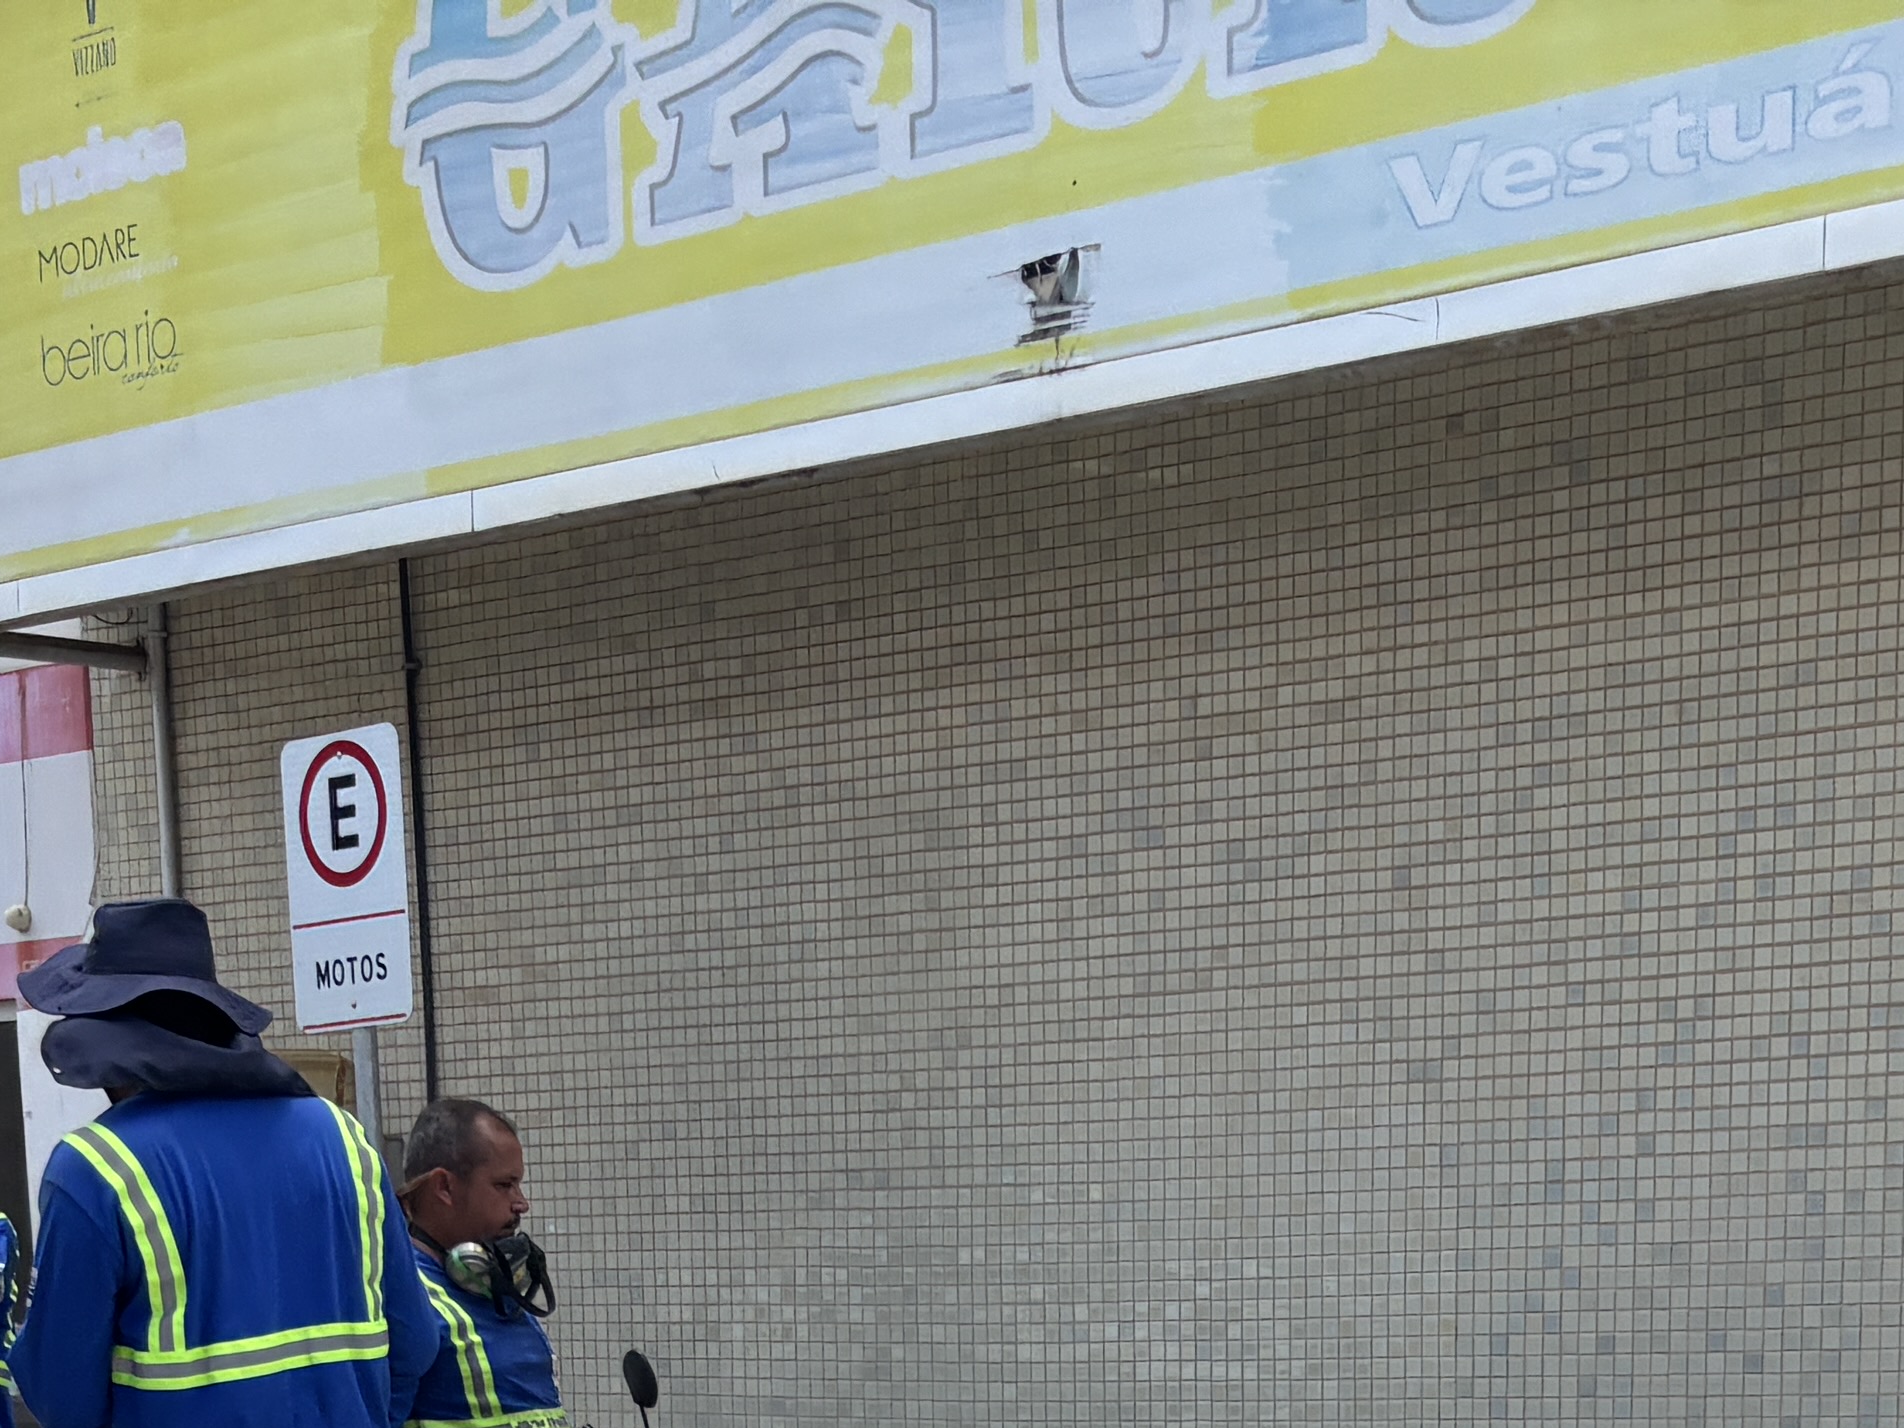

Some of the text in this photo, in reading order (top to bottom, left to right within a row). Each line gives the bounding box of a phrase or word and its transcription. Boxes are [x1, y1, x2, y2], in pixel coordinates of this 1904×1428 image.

[72, 37, 116, 77] VIZZANO
[37, 223, 140, 284] MODARE
[40, 309, 177, 386] beira rio
[328, 773, 360, 851] E
[315, 952, 388, 990] MOTOS
